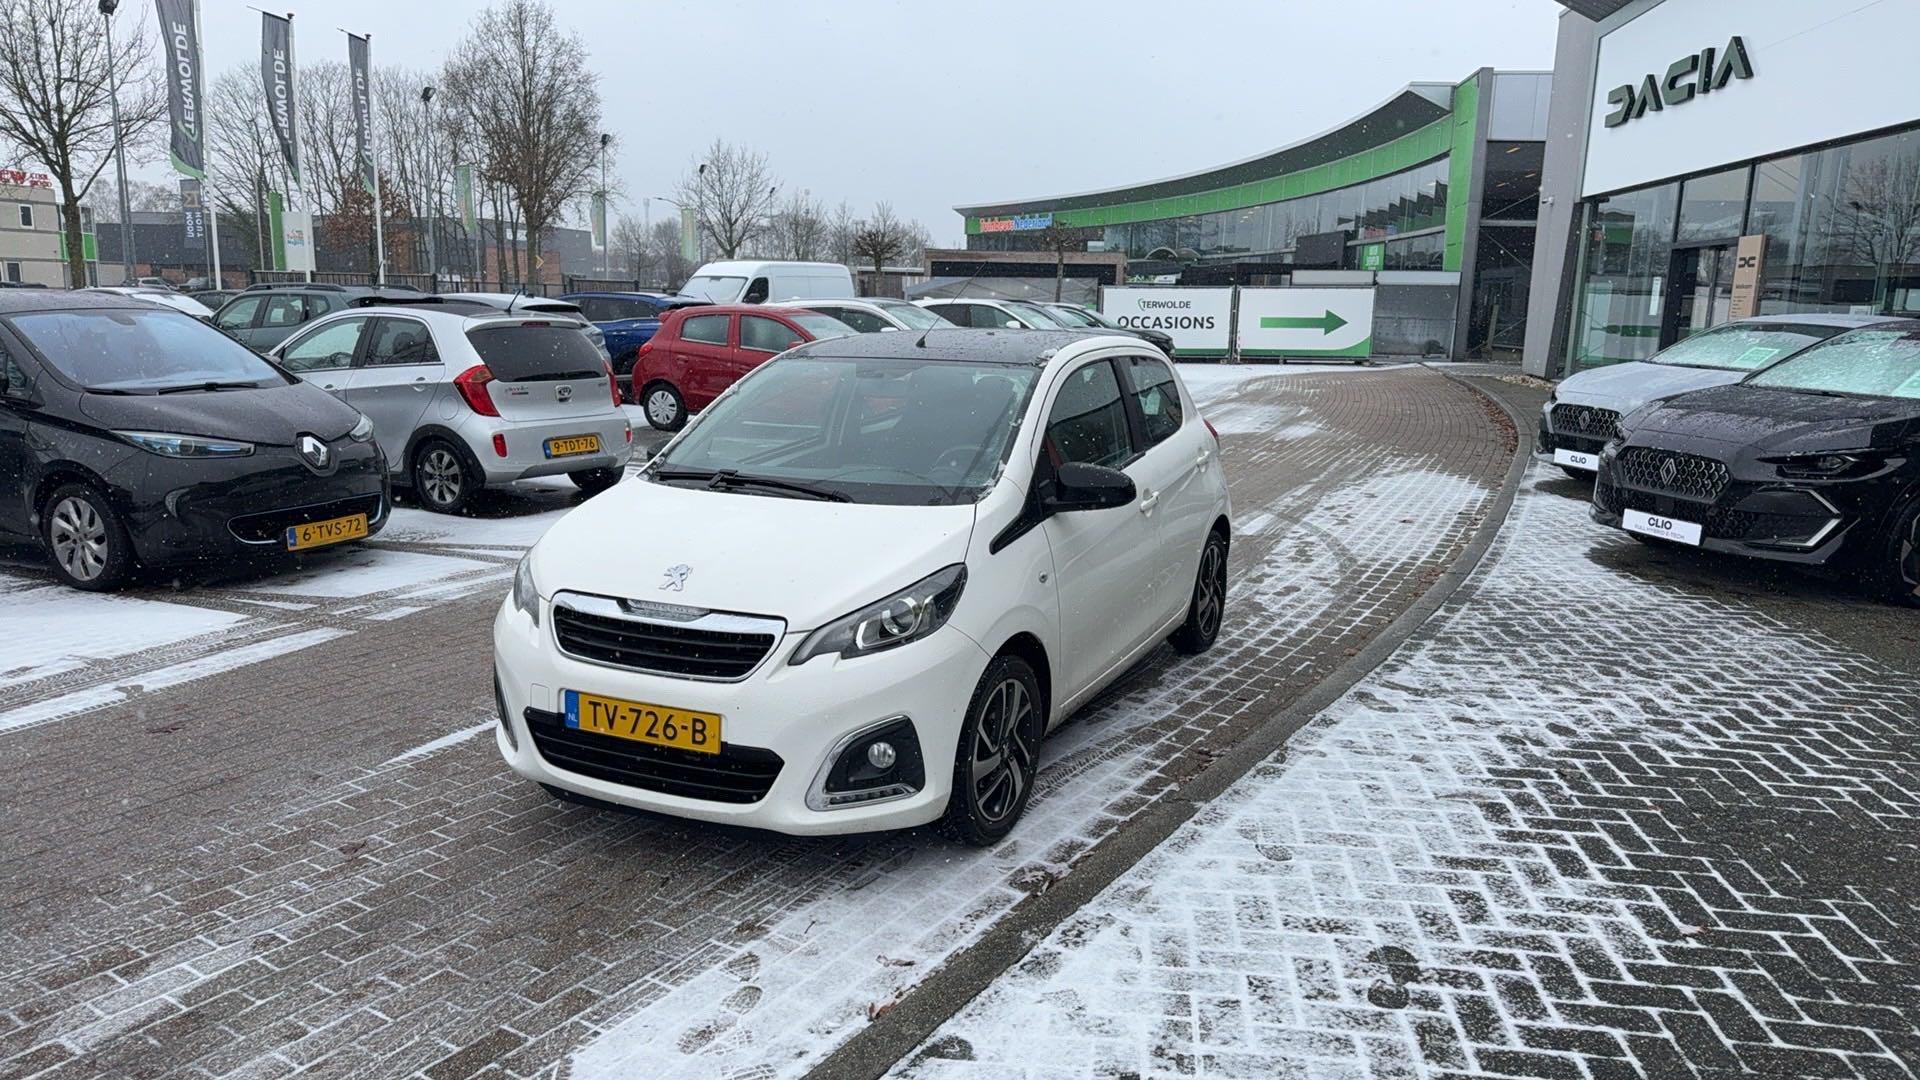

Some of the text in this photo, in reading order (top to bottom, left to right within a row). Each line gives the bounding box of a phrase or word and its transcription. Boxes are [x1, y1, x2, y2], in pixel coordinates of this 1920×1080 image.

[1604, 36, 1754, 128] DACIA
[1141, 300, 1192, 309] TERWOLDE
[1117, 316, 1215, 330] OCCASIONS
[553, 438, 595, 453] 9-TDT-76
[1570, 455, 1587, 464] CLIO
[302, 517, 362, 542] 6-TVS-72
[1647, 516, 1673, 530] CLIO
[567, 712, 578, 722] NL
[588, 700, 707, 745] TV-726-B
